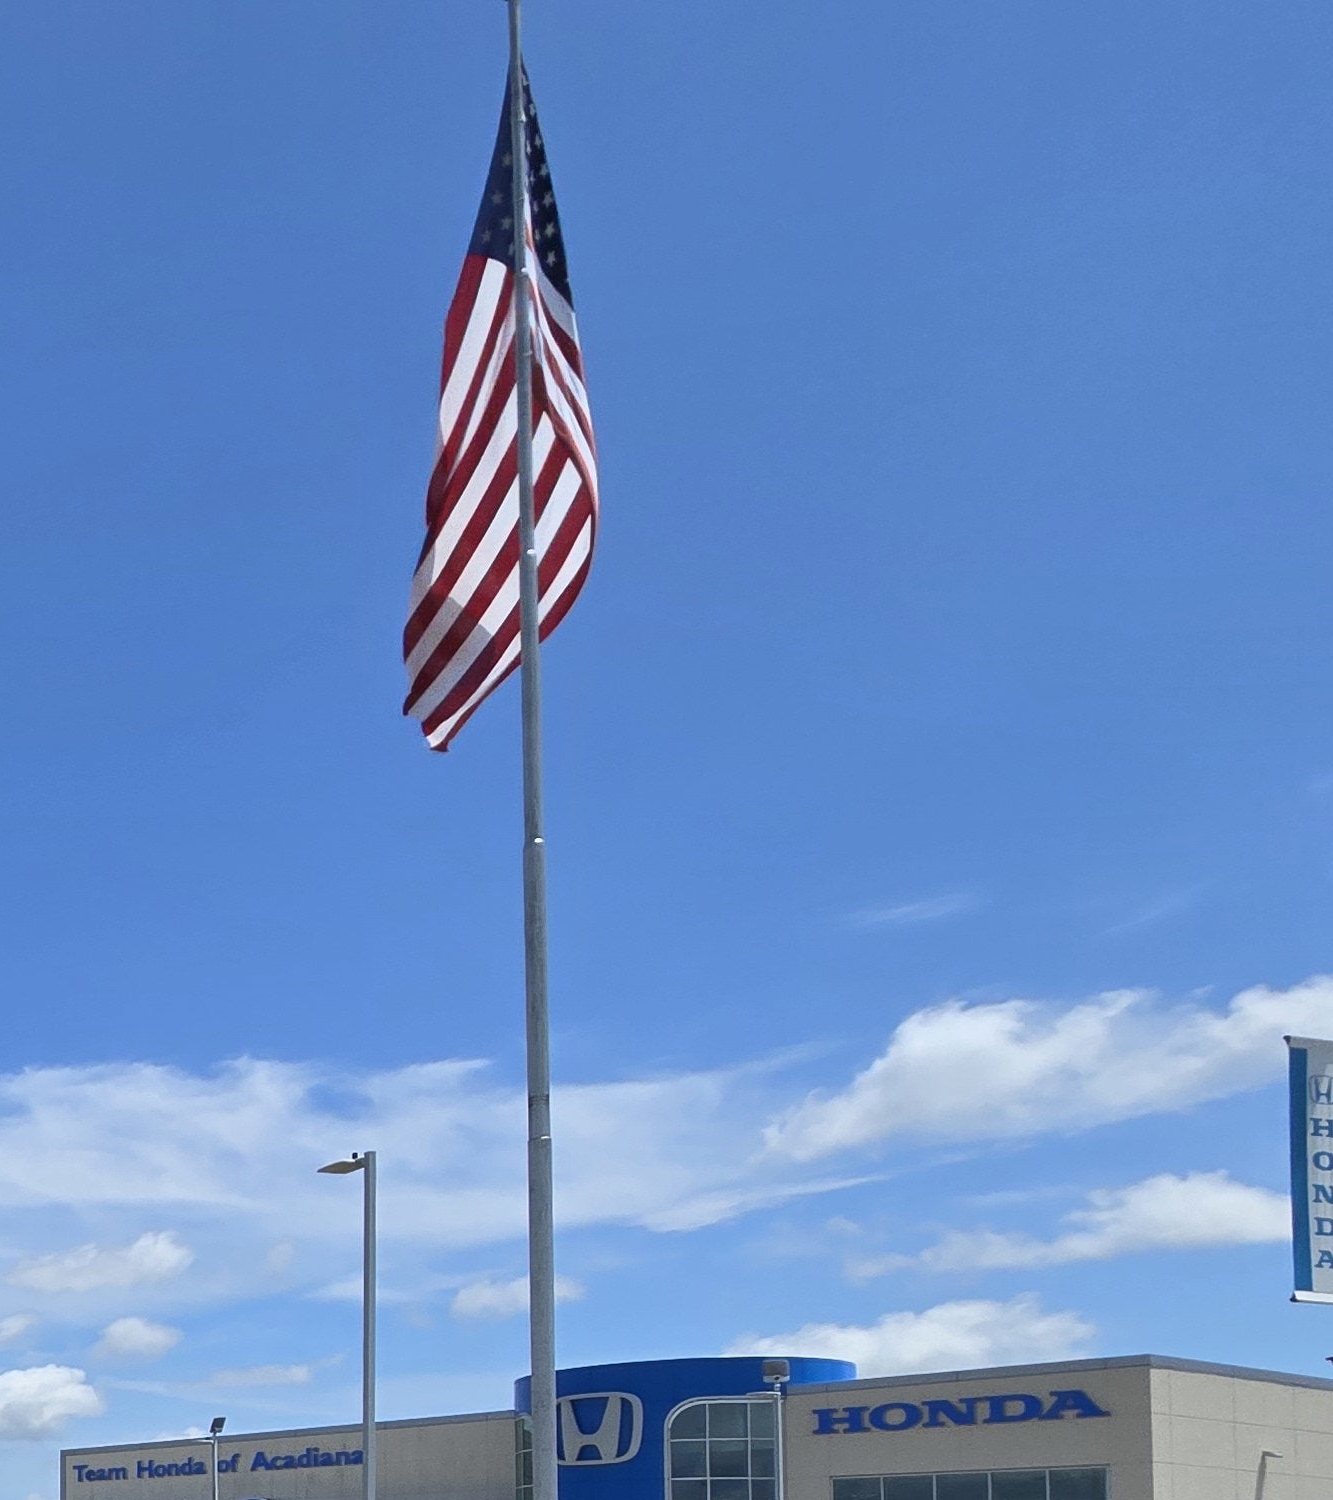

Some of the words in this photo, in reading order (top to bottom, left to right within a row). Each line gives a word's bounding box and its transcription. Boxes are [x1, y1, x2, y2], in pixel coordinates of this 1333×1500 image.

[811, 1389, 1112, 1436] HONDA
[72, 1463, 128, 1483] Team
[136, 1456, 208, 1480] Honda
[217, 1453, 242, 1473] of
[249, 1446, 364, 1473] Acadiana
